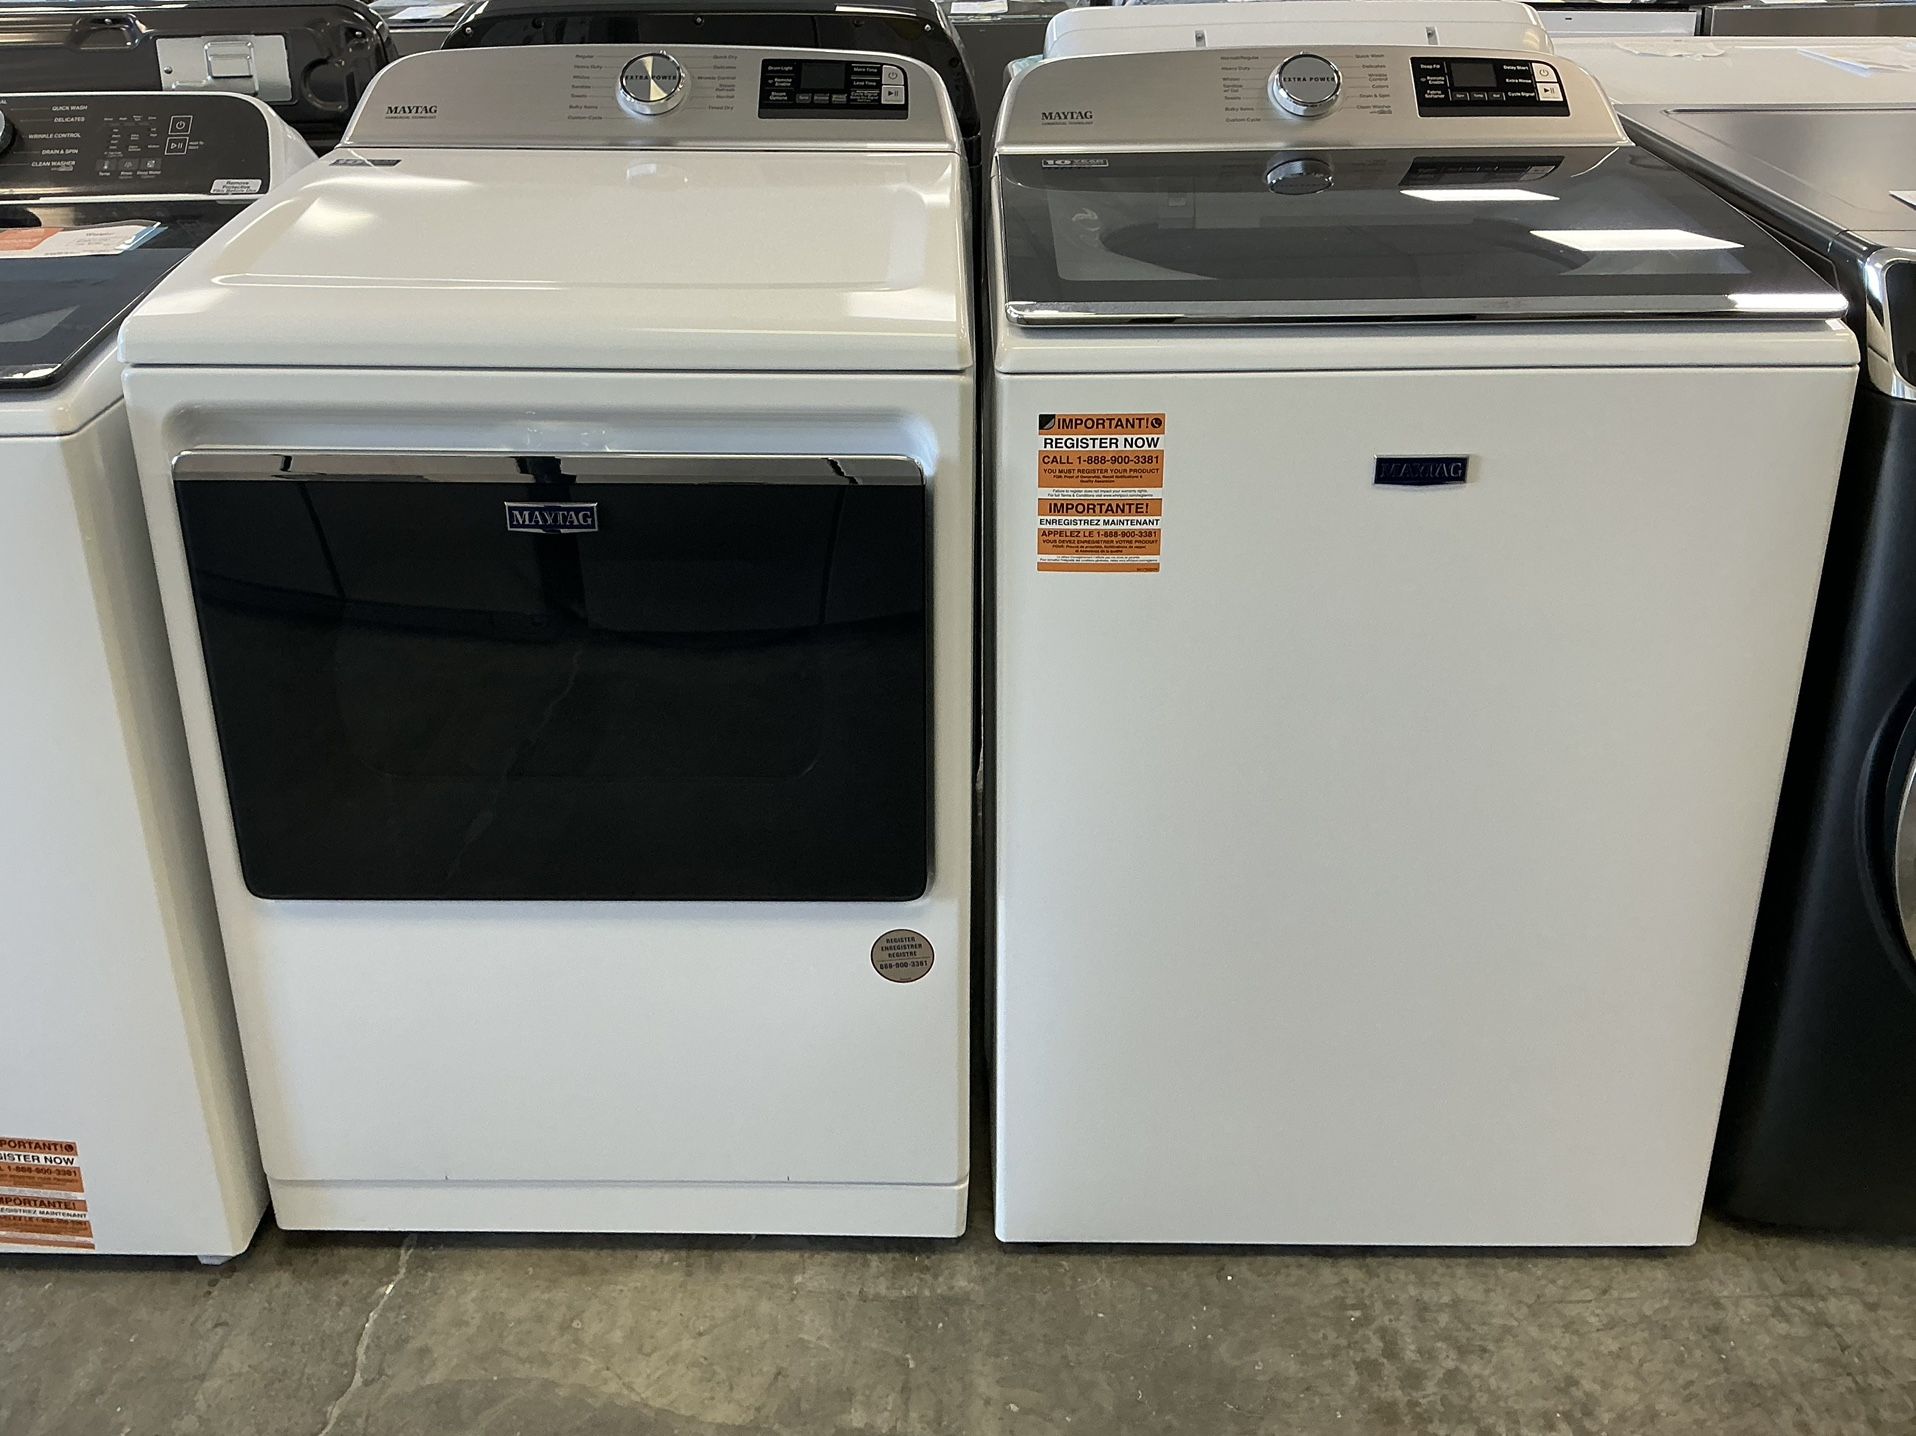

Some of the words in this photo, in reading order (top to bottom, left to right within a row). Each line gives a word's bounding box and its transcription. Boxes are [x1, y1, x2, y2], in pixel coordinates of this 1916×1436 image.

[386, 105, 438, 114] MAYTAG
[1041, 110, 1093, 120] MAYTAG
[1057, 417, 1149, 430] IMPORTANT!
[1043, 437, 1119, 449] REGISTER
[1123, 437, 1160, 448] NOW
[1042, 455, 1073, 465] CALL
[1077, 454, 1159, 465] 1-888-900-3381
[1380, 462, 1462, 478] MAYTAG
[1048, 502, 1149, 514] IMPORTANTE!
[511, 511, 593, 526] MAYTAG
[1039, 518, 1101, 526] ENREGISTREZ
[1102, 518, 1161, 526] MAINTENANT
[1096, 530, 1157, 538] 1-888-900-3381
[886, 936, 916, 944] REGISTER
[881, 944, 923, 952] ENREGISTRER
[880, 960, 928, 970] 888-900-3381
[44, 1156, 74, 1166] NOW
[39, 1210, 87, 1218] MAINTENANT
